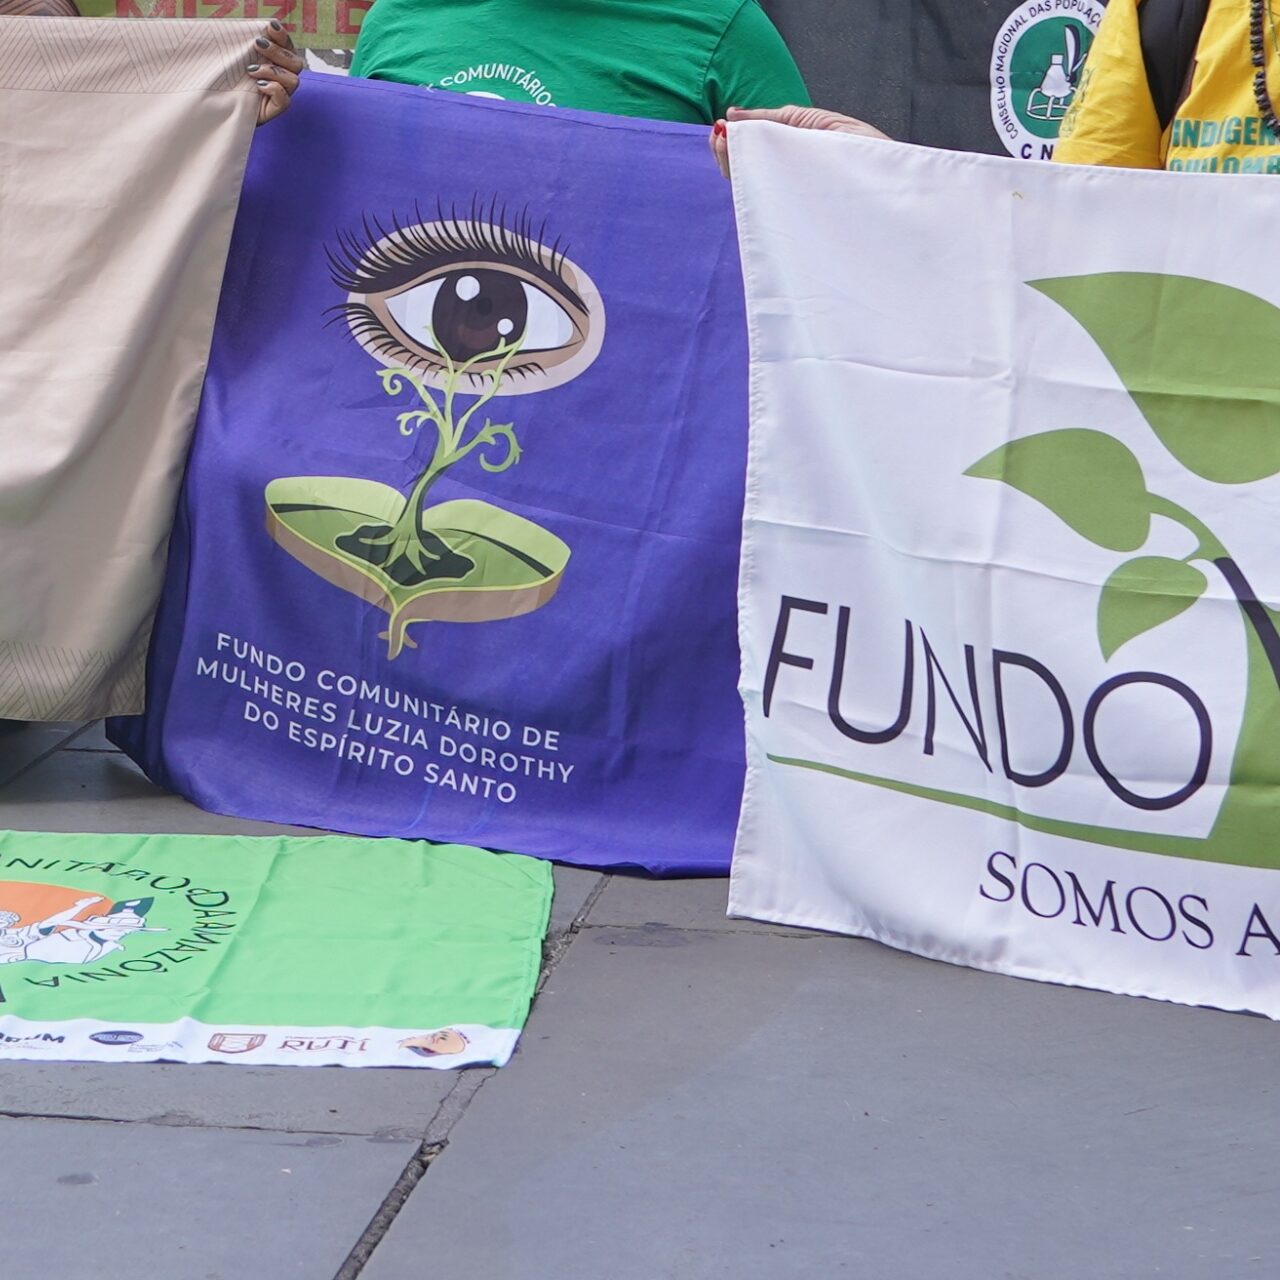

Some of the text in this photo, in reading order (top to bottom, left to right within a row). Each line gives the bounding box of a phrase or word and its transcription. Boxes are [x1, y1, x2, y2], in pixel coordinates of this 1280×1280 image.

[995, 15, 1028, 73] NACIONAL
[1029, 0, 1052, 18] DAS
[995, 76, 1019, 139] CONSELHO
[197, 657, 575, 784] MULHERES LUZIA DOROTHY
[217, 633, 560, 751] FUNDO COMUNITÁRIO DE
[762, 595, 1213, 811] FUNDO
[244, 702, 516, 804] DO ESPÍRITO SANTO
[979, 851, 1214, 950] SOMOS
